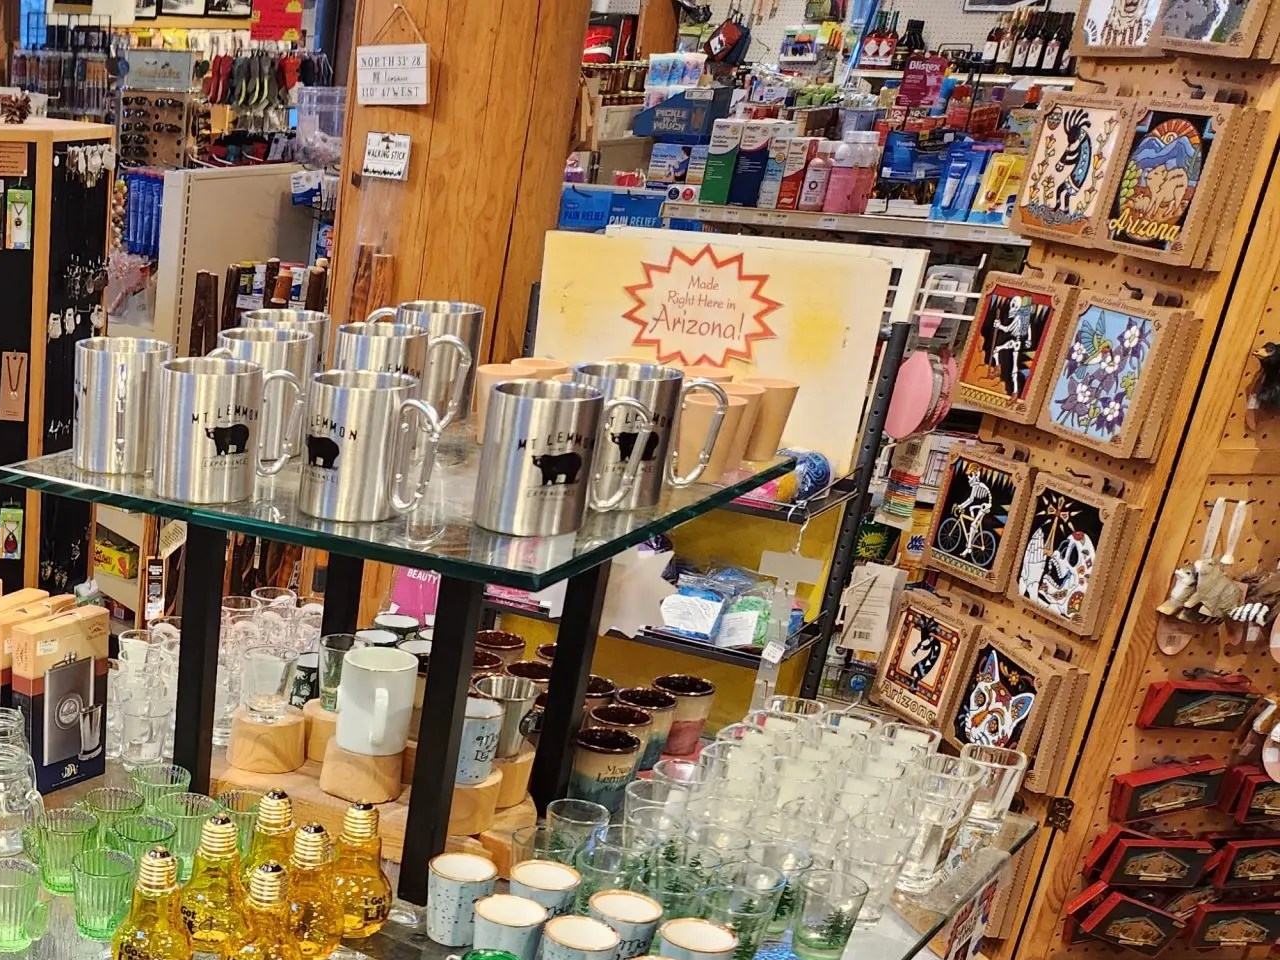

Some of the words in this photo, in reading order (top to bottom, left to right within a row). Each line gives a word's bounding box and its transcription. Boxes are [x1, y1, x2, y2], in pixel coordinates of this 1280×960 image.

[361, 55, 395, 67] NORTH
[412, 56, 421, 66] 28
[908, 59, 941, 73] Blistex
[655, 107, 688, 118] PICKLE
[652, 122, 686, 132] POUCH
[367, 148, 390, 159] WALKING
[390, 149, 406, 160] STICK
[563, 211, 580, 221] PAIN
[581, 211, 605, 221] RELIEF
[609, 215, 629, 226] PAIN
[630, 216, 658, 227] RELIEF
[1109, 207, 1182, 242] Arizona
[687, 275, 719, 291] Made
[667, 290, 695, 308] Right
[697, 294, 724, 309] Here
[727, 298, 736, 310] in
[648, 303, 745, 341] Arizona!
[191, 411, 209, 424] MT
[217, 404, 259, 421] LEMMON
[310, 415, 358, 441] LEMMON
[518, 438, 537, 450] MT
[907, 542, 924, 552] One
[911, 535, 926, 546] We
[406, 568, 438, 584] BEAUTY
[880, 679, 937, 722] Arizona
[180, 905, 197, 919] Got
